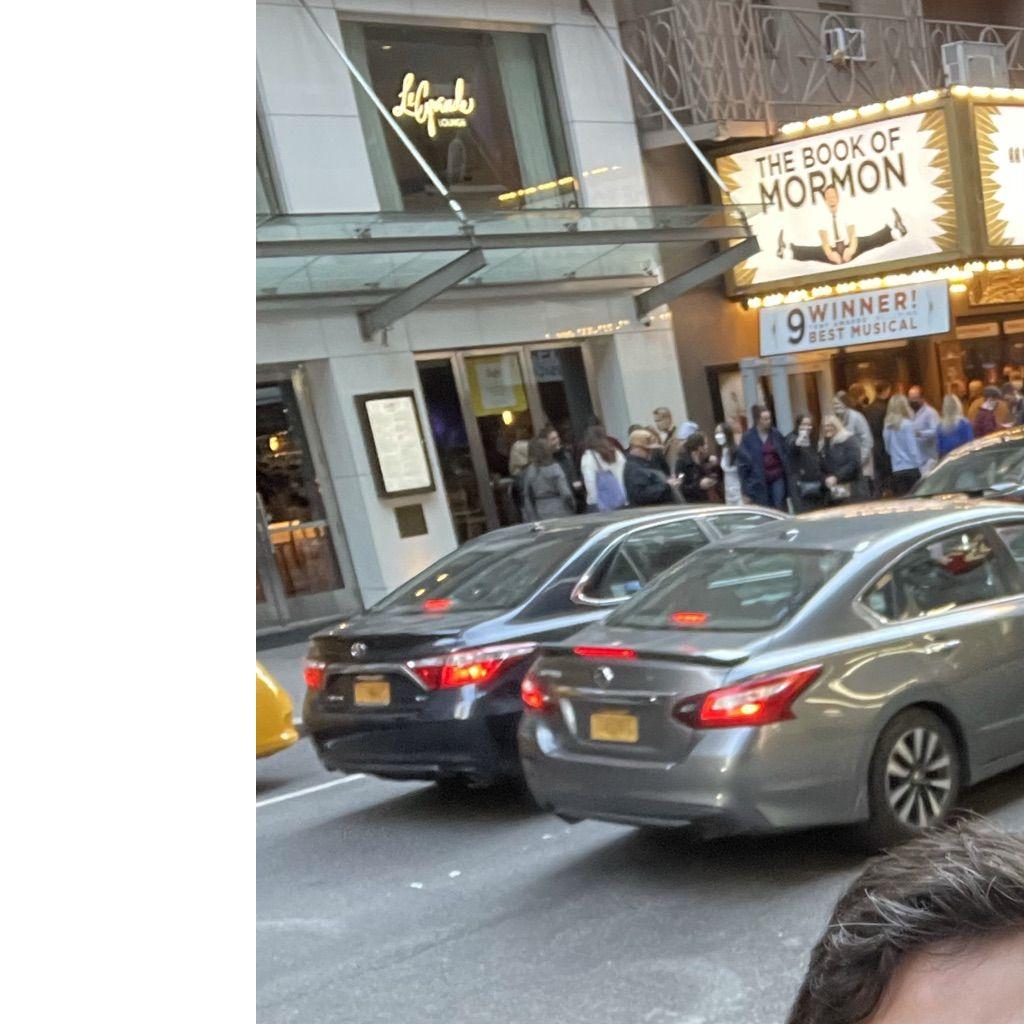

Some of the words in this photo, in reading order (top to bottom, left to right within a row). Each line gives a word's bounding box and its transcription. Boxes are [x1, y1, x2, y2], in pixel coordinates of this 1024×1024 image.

[755, 151, 795, 179] THE
[803, 134, 865, 169] BOOK
[871, 127, 901, 154] OF
[759, 152, 907, 215] MORMON
[786, 308, 805, 345] 9
[808, 290, 917, 323] WINNER!
[808, 328, 845, 344] BEST
[851, 317, 917, 339] MUSICAL
